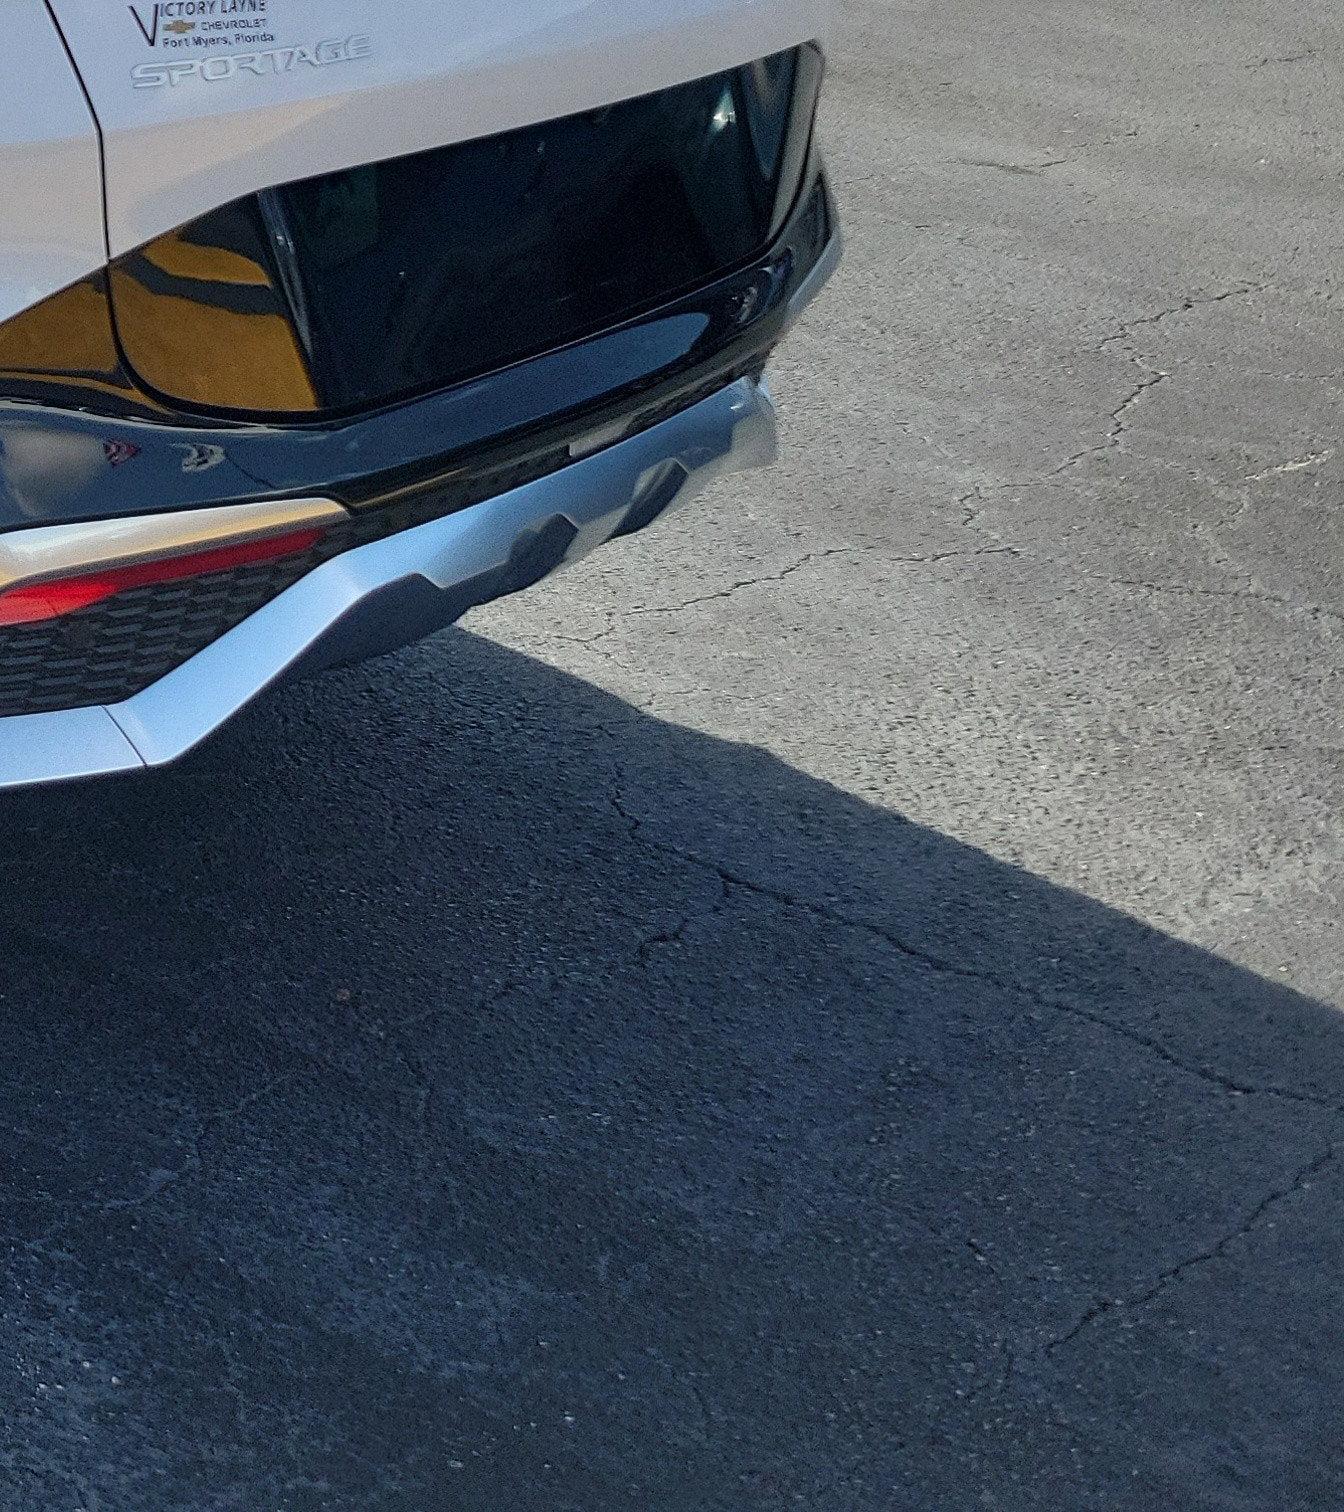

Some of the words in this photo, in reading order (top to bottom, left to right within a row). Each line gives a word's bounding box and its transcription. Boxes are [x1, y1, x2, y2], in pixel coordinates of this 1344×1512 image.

[128, 1, 216, 47] VICTORY
[201, 19, 267, 31] CHEVROLET
[163, 37, 189, 48] Fort
[194, 35, 232, 48] Myers,
[235, 33, 275, 44] Florida
[129, 34, 373, 89] SPORTAGE
